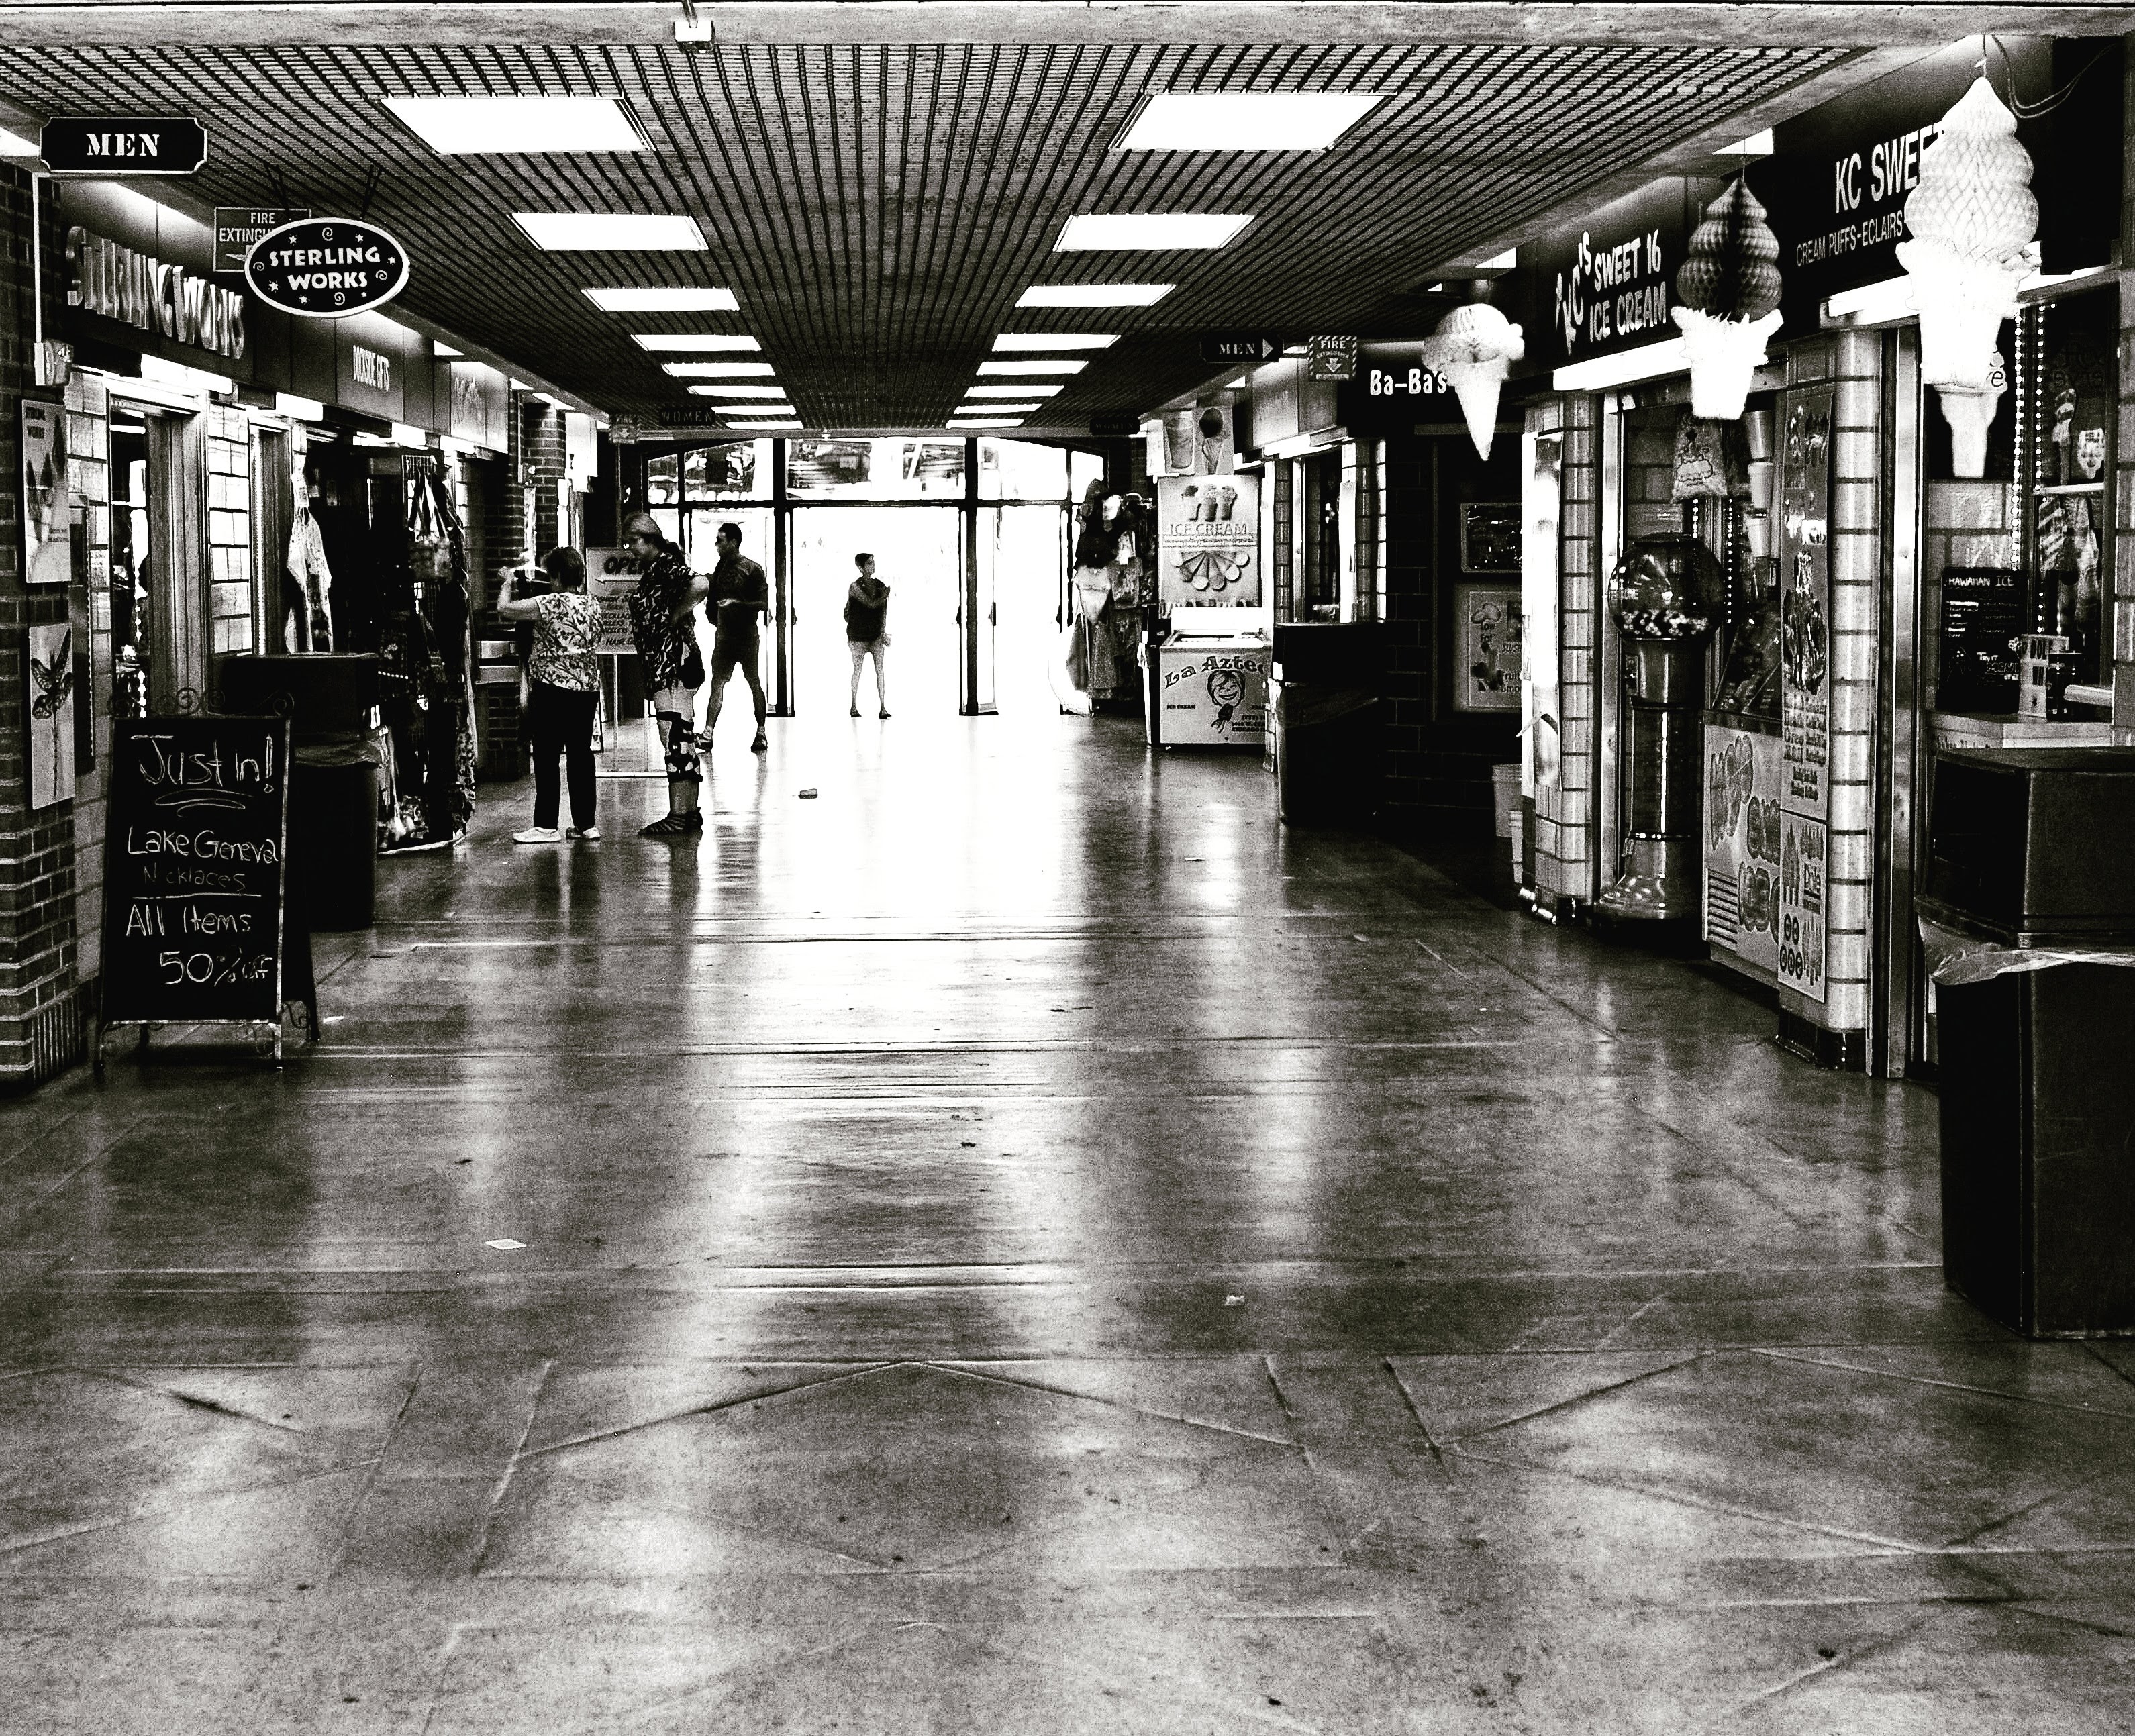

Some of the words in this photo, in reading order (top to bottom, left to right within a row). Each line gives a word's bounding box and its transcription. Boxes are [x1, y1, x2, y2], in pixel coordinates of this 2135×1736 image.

[86, 134, 160, 156] MEN
[1835, 152, 1862, 214] KC
[250, 212, 275, 224] FIRE
[1796, 235, 1826, 267] CREAM
[1828, 209, 1903, 257] PUFFS-ECLAIRS
[269, 246, 381, 267] STERLING
[1594, 236, 1642, 292] SWEET
[1646, 229, 1662, 274] 16
[287, 271, 368, 291] WORKS
[1589, 299, 1611, 343] ICE
[1616, 281, 1667, 336] CREAM
[1219, 343, 1255, 354] MEN
[1320, 340, 1346, 349] FIRE
[1370, 368, 1447, 395] Ba-Ba's
[662, 410, 712, 422] WOMEN
[1170, 523, 1192, 536] ICE
[1195, 523, 1247, 536] CREAM
[604, 556, 643, 574] OPE
[1995, 575, 2014, 586] ICE
[1164, 666, 1197, 689] La
[131, 735, 224, 787] Just
[128, 825, 189, 856] Lake
[193, 829, 279, 864] Geneva
[144, 862, 246, 892] Ncklaces
[126, 903, 166, 937] All
[183, 904, 252, 935] Items
[159, 947, 242, 987] 50%
